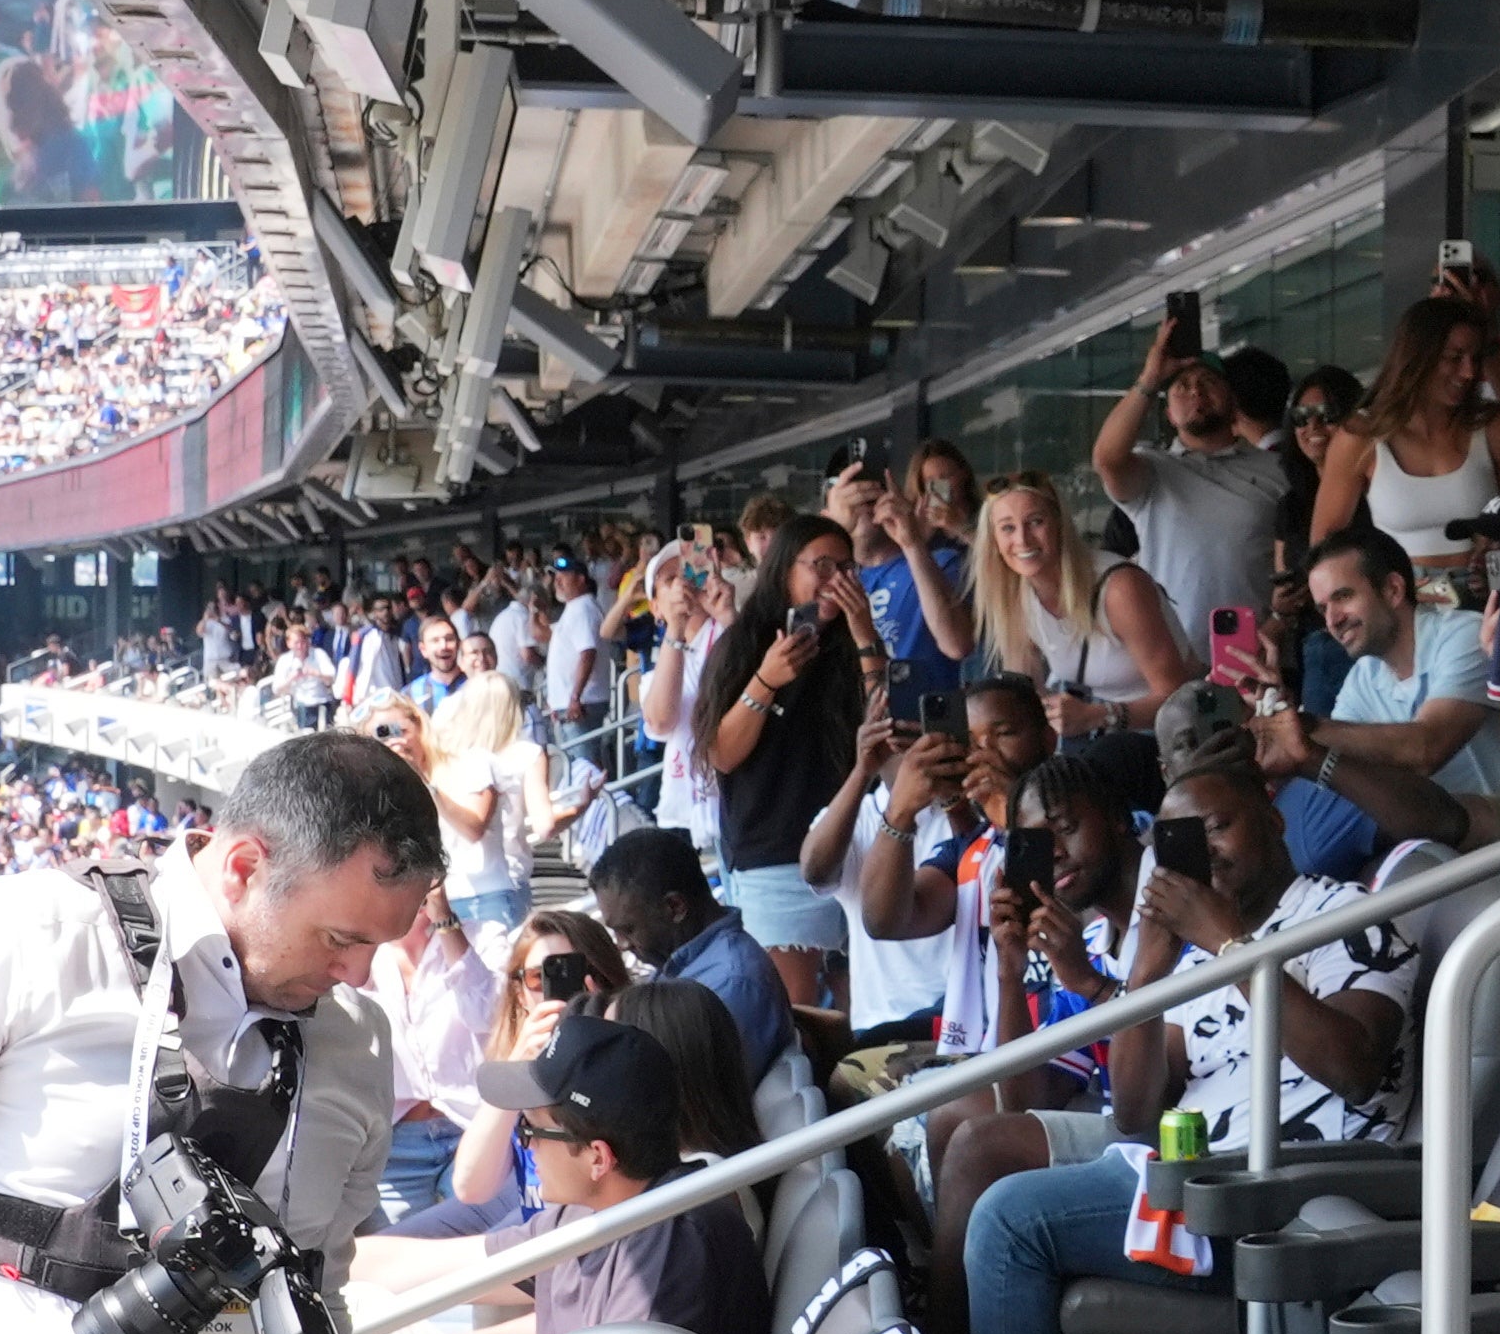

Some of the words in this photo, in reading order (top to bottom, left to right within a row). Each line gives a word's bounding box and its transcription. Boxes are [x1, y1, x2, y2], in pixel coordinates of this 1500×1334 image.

[134, 1068, 145, 1105] WORLD
[132, 1106, 142, 1127] CUP
[130, 1128, 141, 1159] 2025
[204, 1321, 233, 1333] ROK
